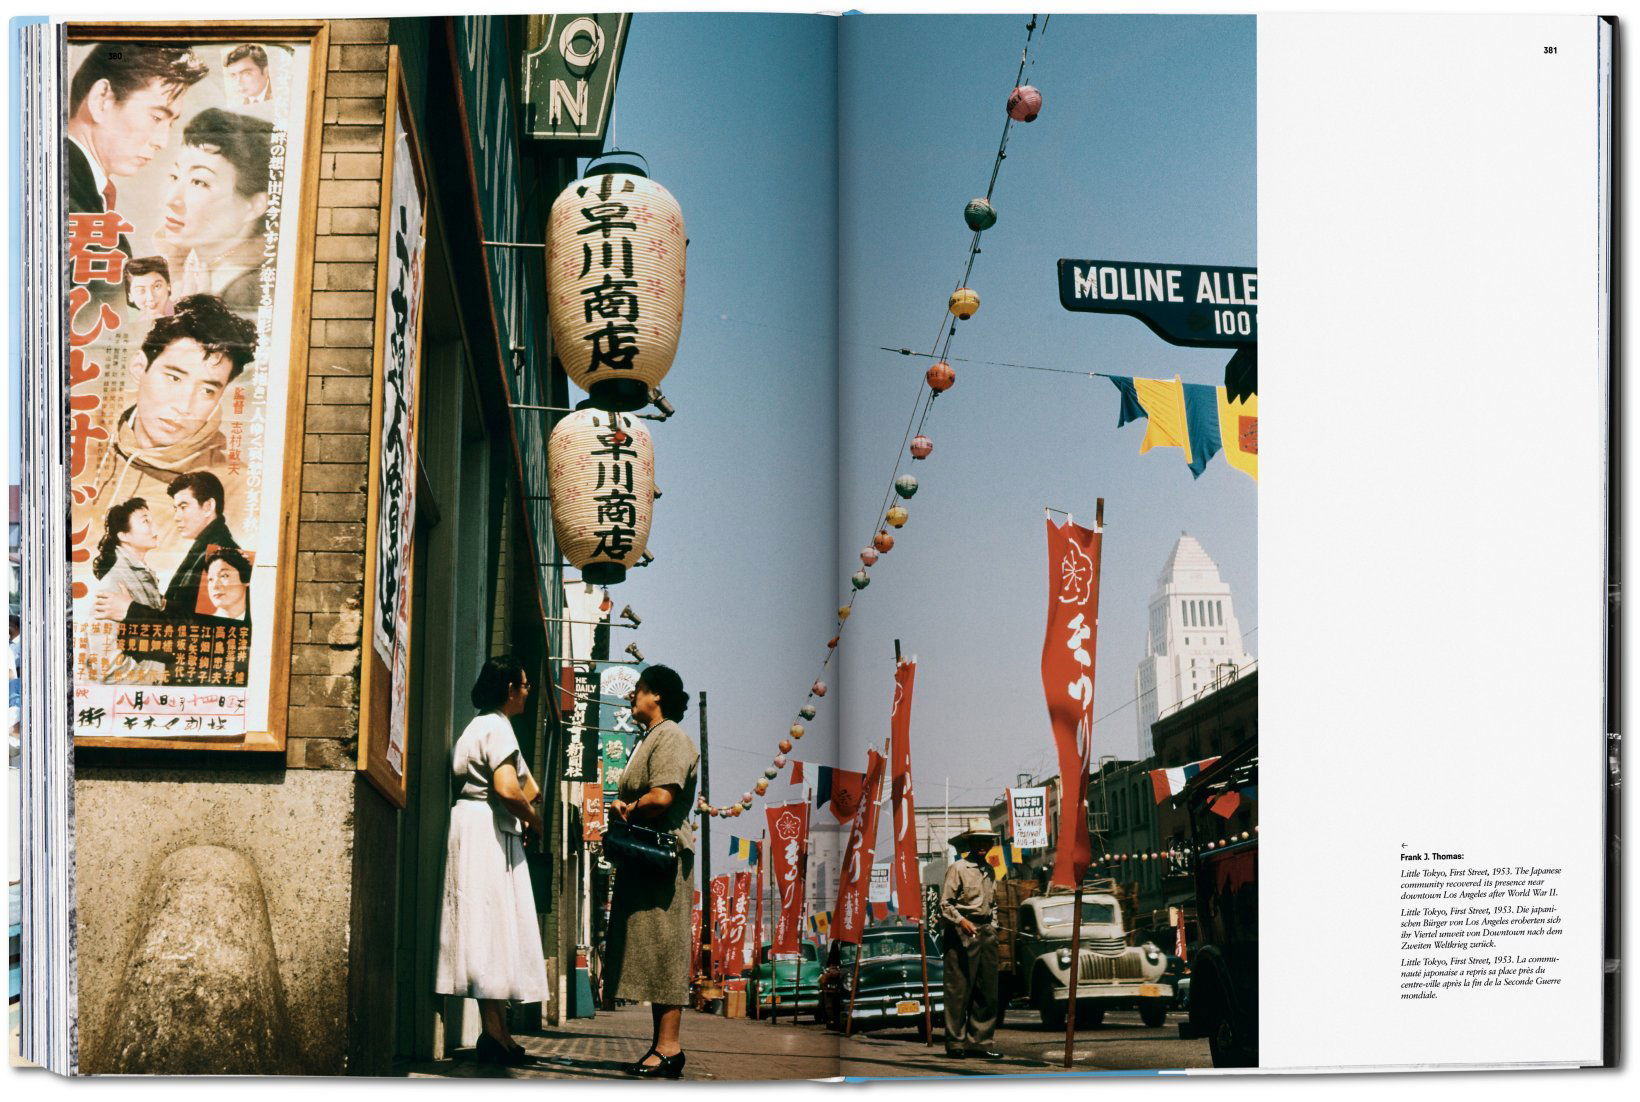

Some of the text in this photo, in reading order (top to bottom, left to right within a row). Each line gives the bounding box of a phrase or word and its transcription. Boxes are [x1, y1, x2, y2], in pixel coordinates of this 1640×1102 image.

[108, 52, 123, 60] 380
[1543, 46, 1558, 54] 381
[576, 173, 640, 374] 小早川商店
[1073, 266, 1184, 303] MOLINE
[1214, 310, 1251, 336] 100
[590, 411, 638, 560] 小早川商店
[575, 684, 597, 693] DAILY
[1015, 798, 1041, 807] NISEI
[1015, 807, 1043, 817] WEEK
[1400, 852, 1464, 861] Frank J. Thomas:
[1401, 867, 1562, 879] Little Tokyo, First Street, 1953. The Japanese
[1400, 880, 1444, 889] community
[1446, 879, 1483, 888] recovered
[1483, 879, 1493, 887] its
[1494, 880, 1527, 889] presence
[1400, 887, 1558, 900] downtown Los Angeles after World War II.
[1401, 905, 1557, 917] Little Tokyo, First Street, 1953. Die japani-
[729, 893, 747, 943] まつり
[1400, 919, 1421, 928] schen
[1423, 916, 1448, 928] Bürger
[1465, 918, 1479, 926] Los
[1481, 917, 1509, 927] Angeles
[1510, 917, 1546, 926] eroberten
[1546, 915, 1561, 924] sich
[1401, 930, 1412, 939] ihr
[1414, 930, 1438, 938] Viertel
[1439, 929, 1465, 938] unweit
[1482, 928, 1525, 937] Downtown
[1527, 927, 1545, 936] nach
[1546, 927, 1563, 935] dem
[1401, 939, 1496, 950] Zweiten Weltkrieg zurück.
[1401, 958, 1421, 966] Little
[1423, 957, 1448, 968] Tokyo,
[1450, 957, 1467, 965] First
[1468, 957, 1491, 965] Street,
[1494, 955, 1514, 964] 1953.
[1516, 955, 1527, 963] La
[1423, 969, 1458, 979] japonaise
[1466, 967, 1487, 978] repris
[1497, 966, 1517, 977] place
[1518, 966, 1534, 976] près
[1535, 966, 1546, 974] du
[1400, 977, 1561, 989] centre-ville après la fin de la Seconde Guerre
[1401, 989, 1438, 999] mondiale.
